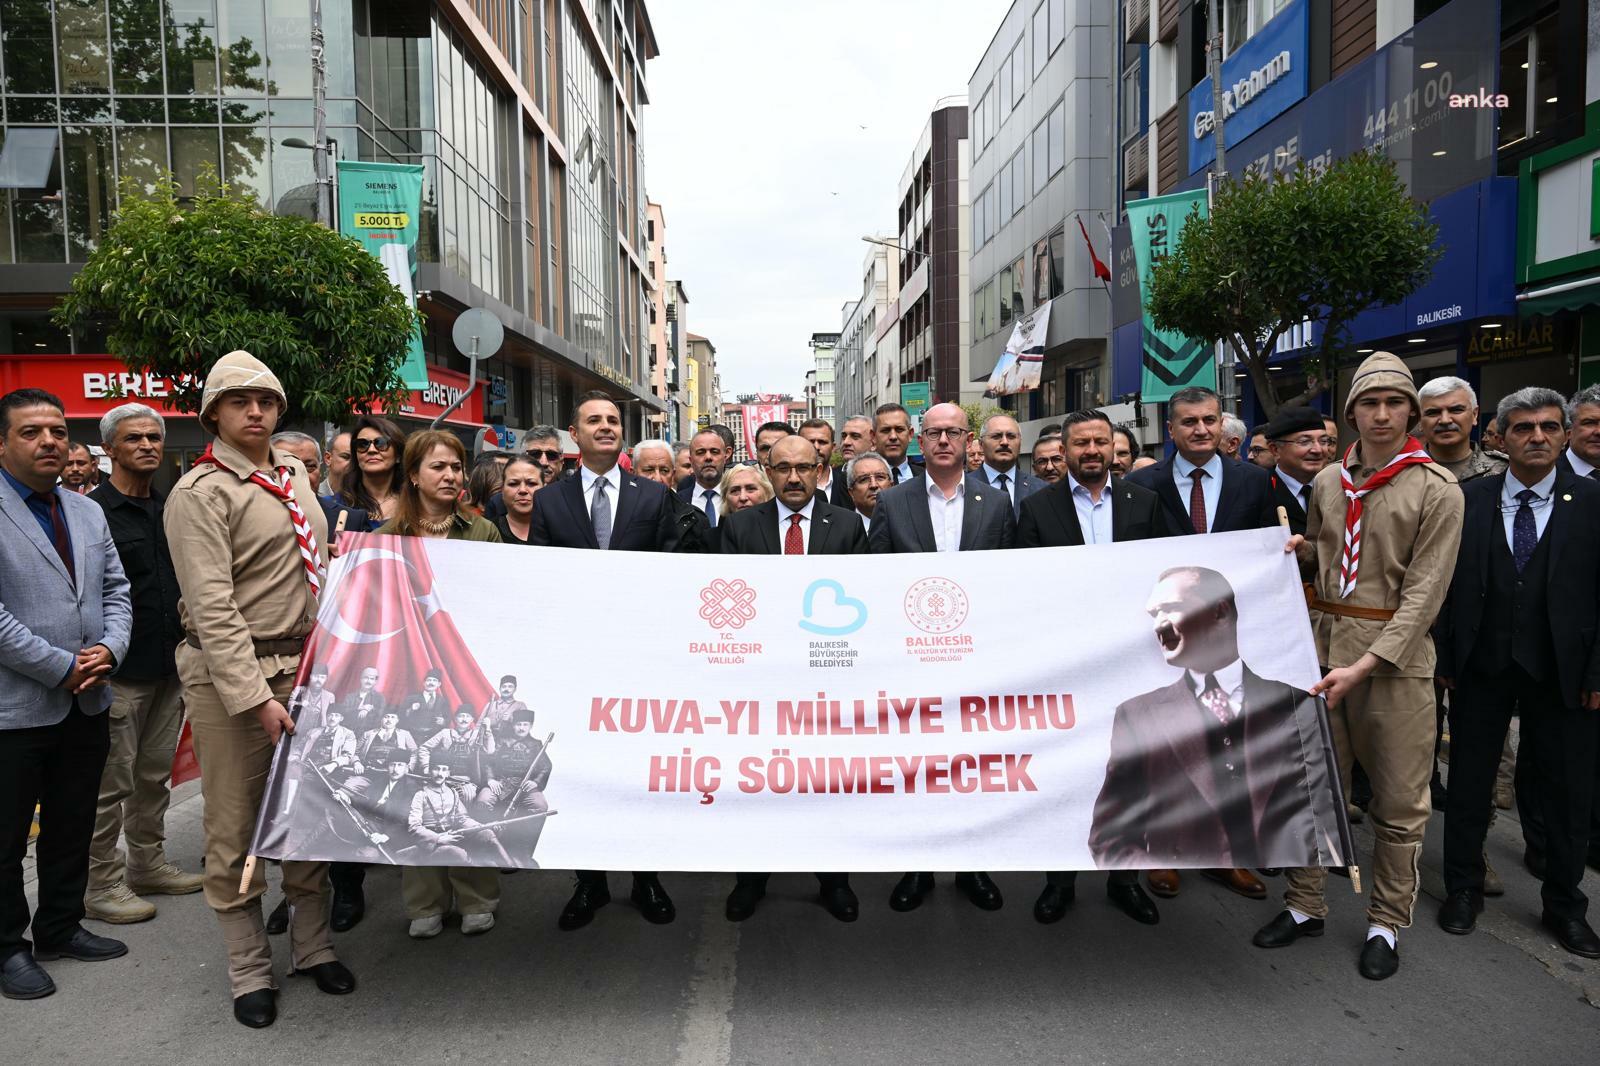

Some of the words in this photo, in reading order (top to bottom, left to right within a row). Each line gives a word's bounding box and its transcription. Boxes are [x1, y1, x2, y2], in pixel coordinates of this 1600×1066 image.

[1363, 101, 1400, 139] 444
[1424, 71, 1453, 109] 00
[1193, 90, 1236, 140] Geik
[1275, 136, 1298, 172] DE
[365, 182, 398, 190] SIEMENS
[360, 216, 390, 226] 5.000
[1417, 304, 1462, 326] BALIKESİR
[720, 632, 734, 640] T.C.
[906, 634, 973, 647] BALIKESİR
[689, 642, 762, 654] BALIKESİR
[809, 640, 849, 649] BALIKESİR
[809, 648, 858, 659] BÜYÜKŞEHİR
[809, 658, 853, 668] BELEDİYESİ
[588, 697, 760, 735] KUVA-YI
[776, 691, 945, 736] MİLLİYE
[960, 693, 1076, 732] RUHU
[647, 747, 721, 805] HİÇ
[737, 748, 1039, 794] SÖNMEYECEK
